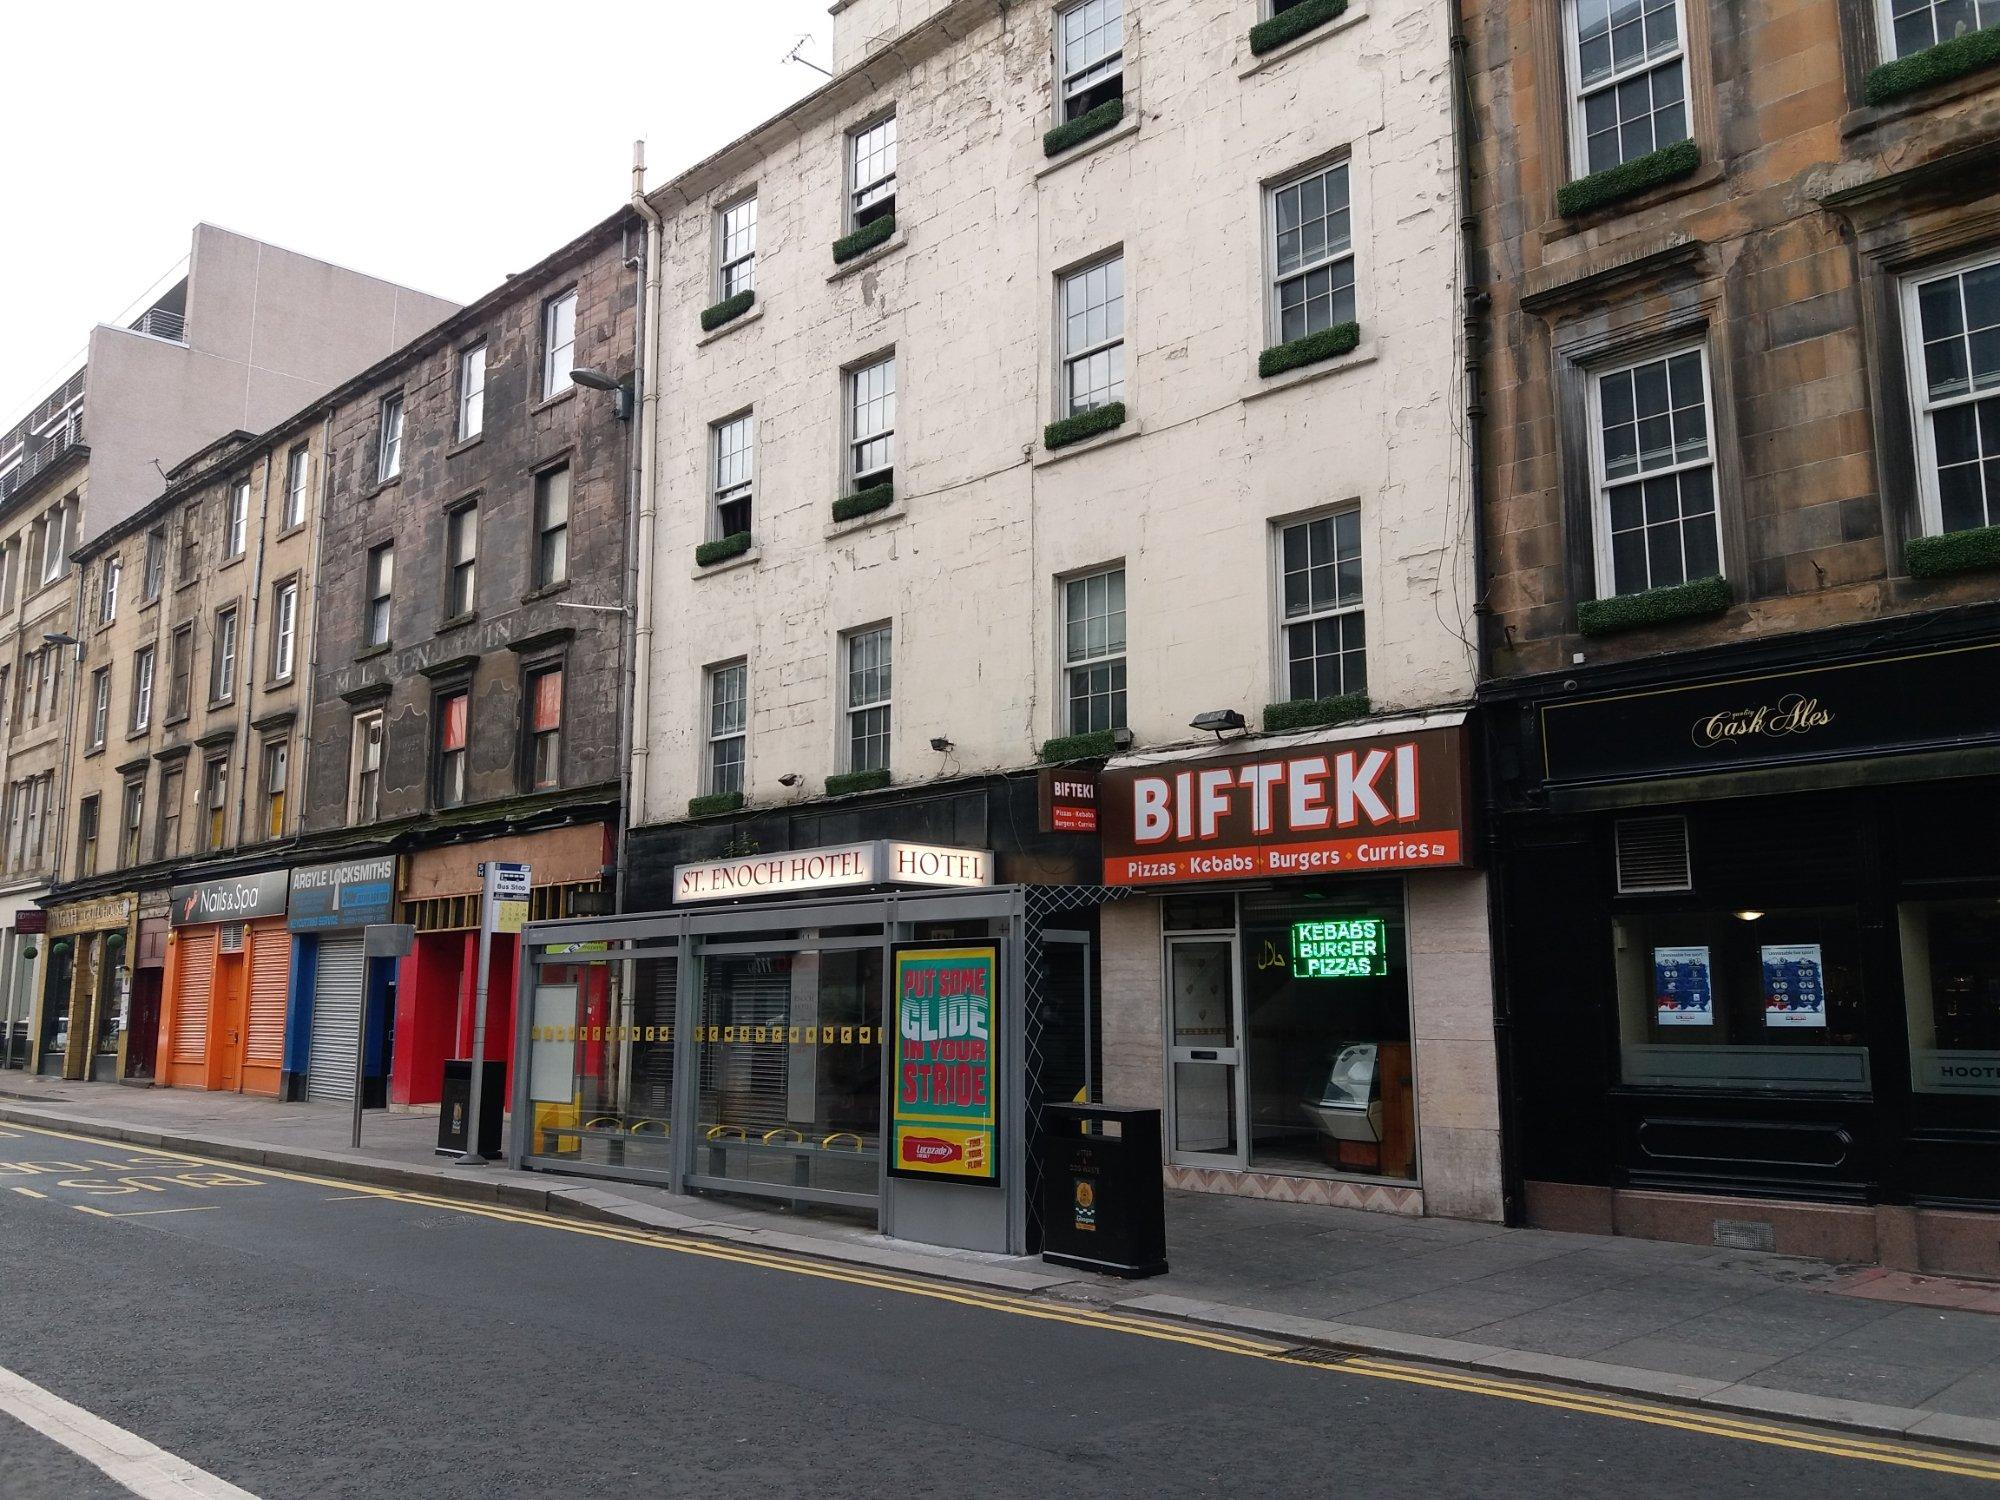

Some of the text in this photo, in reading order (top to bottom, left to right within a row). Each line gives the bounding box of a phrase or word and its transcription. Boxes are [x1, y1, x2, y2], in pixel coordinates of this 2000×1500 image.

[1692, 694, 1835, 748] Cask Ales
[1054, 781, 1094, 798] BIFTEKI
[1133, 742, 1420, 845] BIFTEKI
[1055, 809, 1072, 817] Pizzas
[1055, 820, 1075, 828] Burgers
[897, 849, 985, 883] HOTEL
[1127, 860, 1176, 878] Pizzas
[1190, 854, 1253, 874] Kebabs
[1269, 849, 1340, 870] Burgers
[1356, 840, 1429, 863] Curries
[293, 860, 392, 890] ARGYLE LOCKSMITHS
[681, 851, 865, 895] ST. ENOCH HOTEL
[511, 883, 526, 891] Stop
[1300, 922, 1377, 941] KEBABS
[1257, 940, 1286, 970] حلال
[1300, 940, 1377, 958] BURGER
[1308, 957, 1372, 975] PIZZAS
[904, 967, 987, 998] PUT SOME
[901, 994, 988, 1042] GLIDE
[903, 1039, 986, 1062] IN YOUR
[902, 1062, 987, 1107] STRIDE
[916, 1144, 947, 1156] Lucozade
[57, 1172, 268, 1195] BUS
